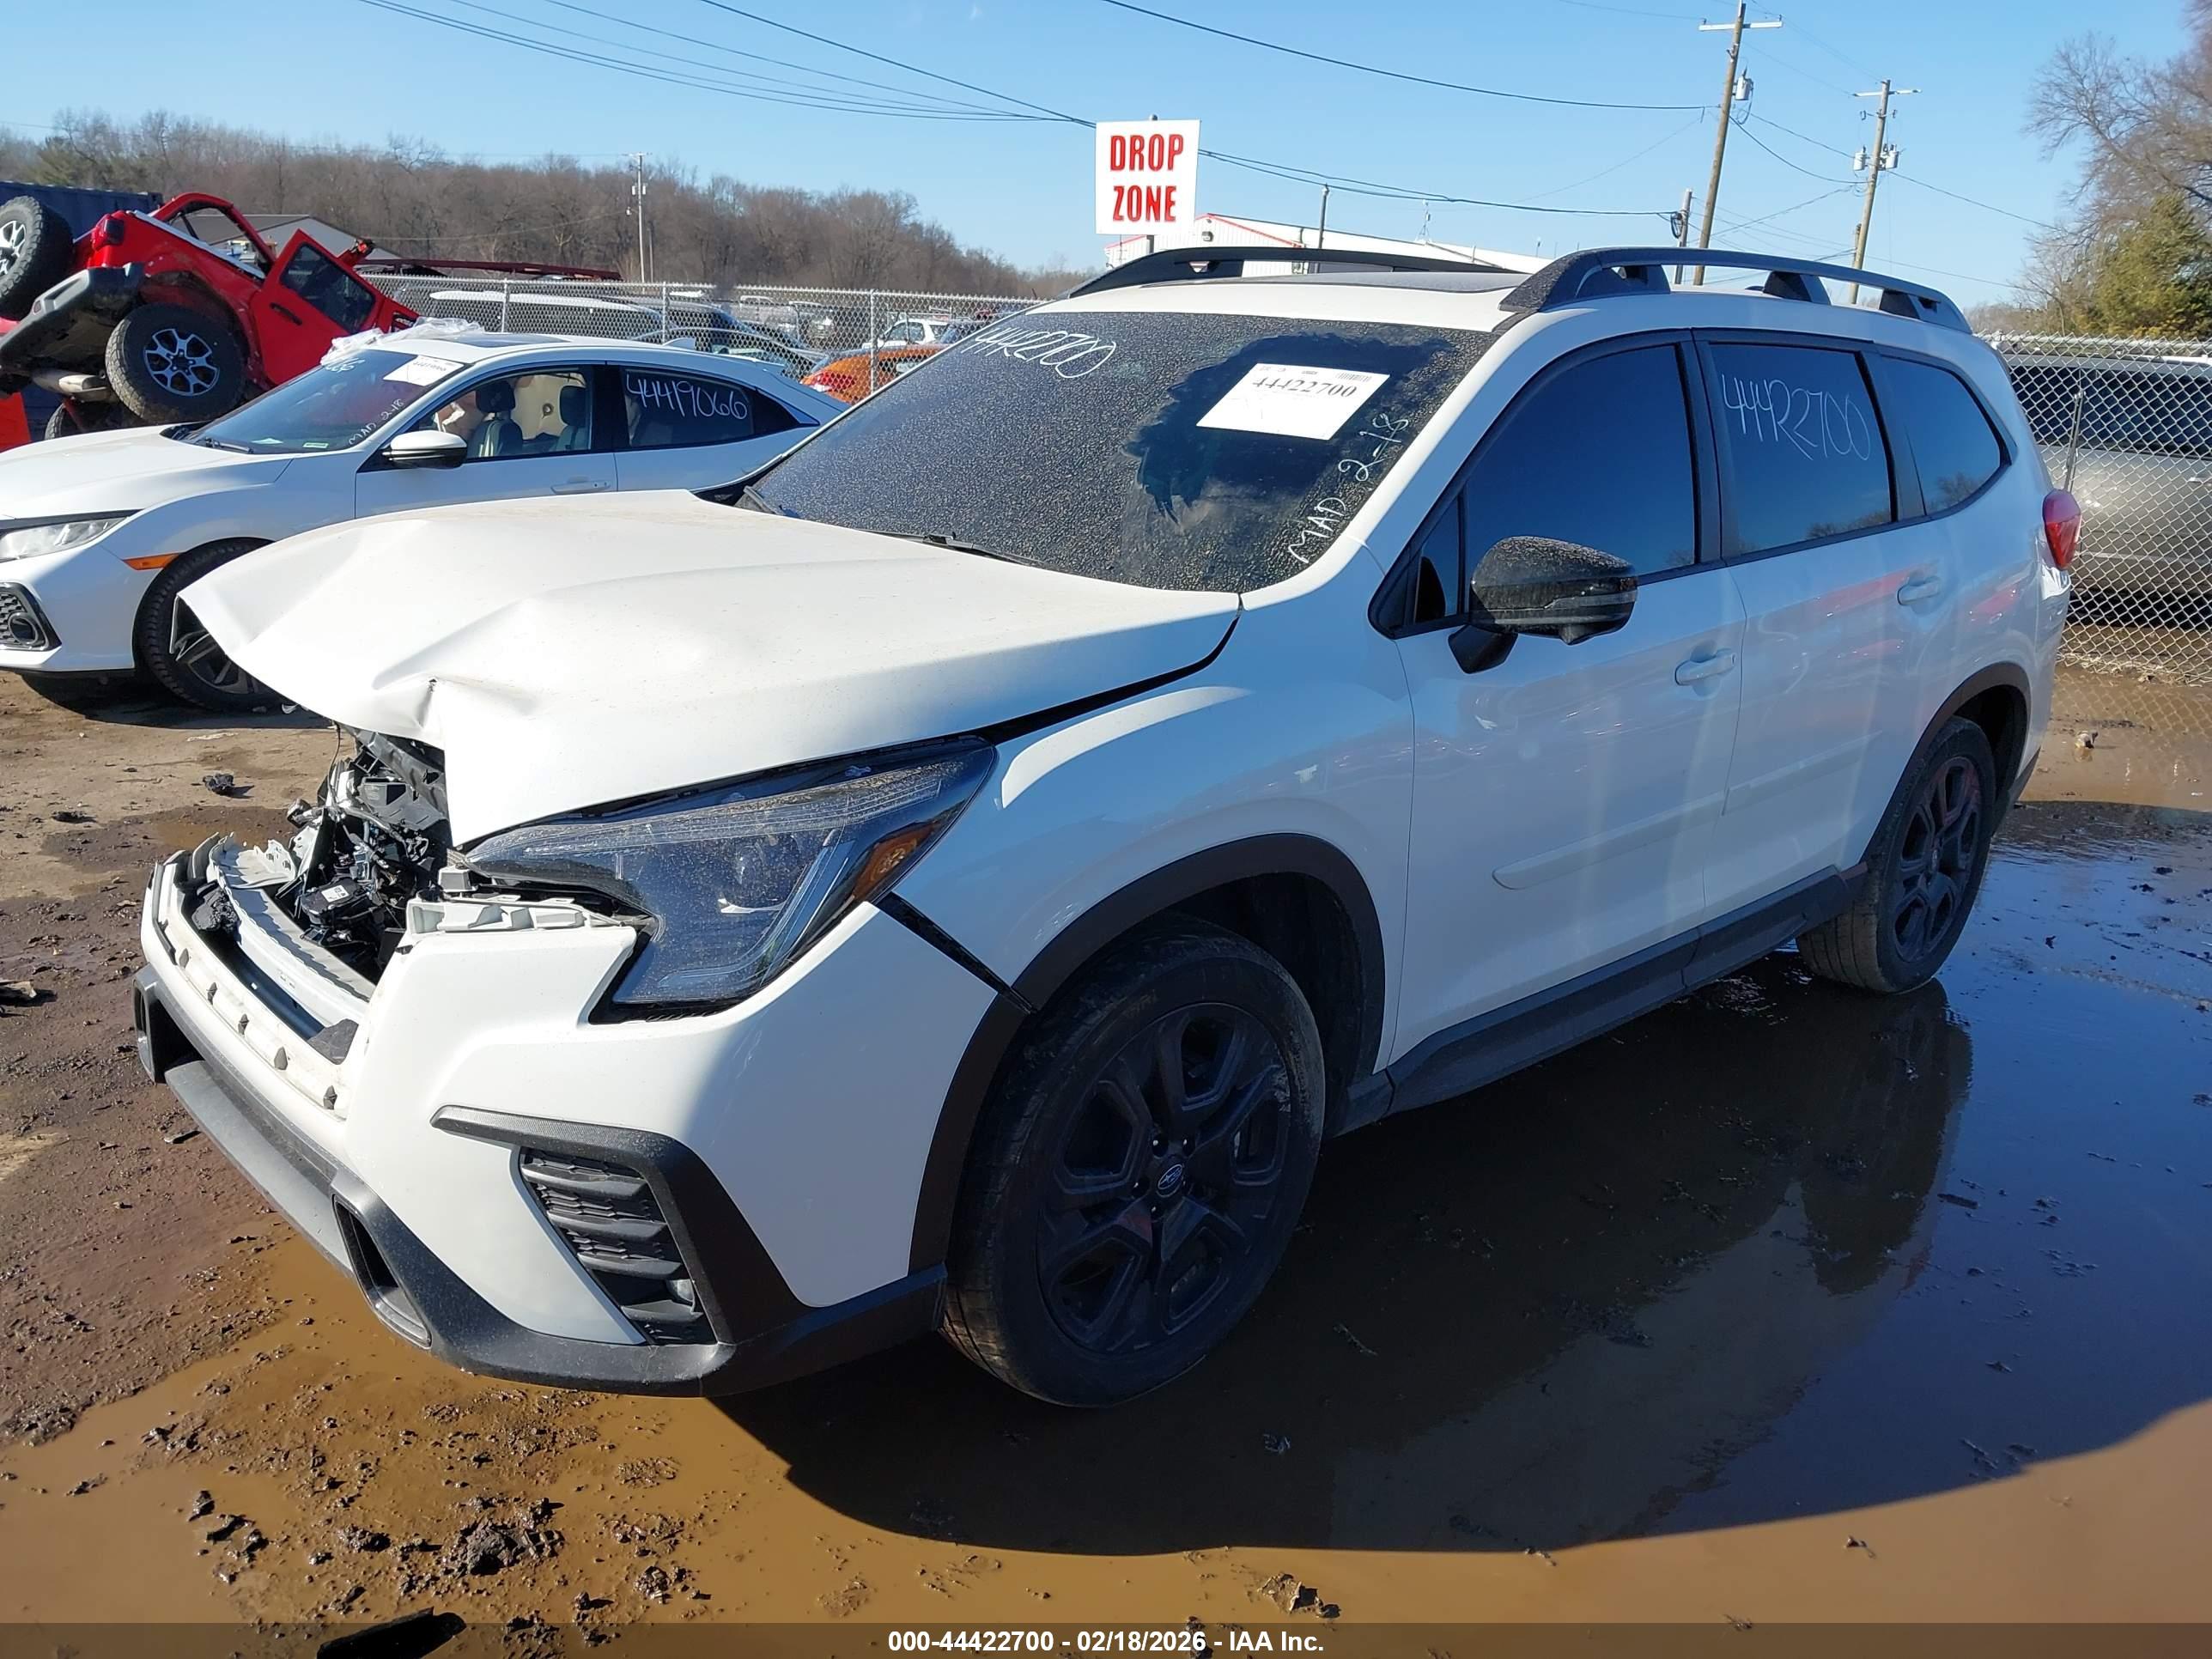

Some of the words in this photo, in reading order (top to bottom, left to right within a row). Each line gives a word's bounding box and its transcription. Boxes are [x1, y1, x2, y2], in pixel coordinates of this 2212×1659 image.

[1109, 133, 1184, 172] DROP
[1112, 185, 1177, 222] ZONE
[625, 373, 748, 420] 44419066
[1252, 376, 1358, 398] 44422700
[1287, 496, 1347, 564] MAD
[1337, 412, 1409, 483] 2-18
